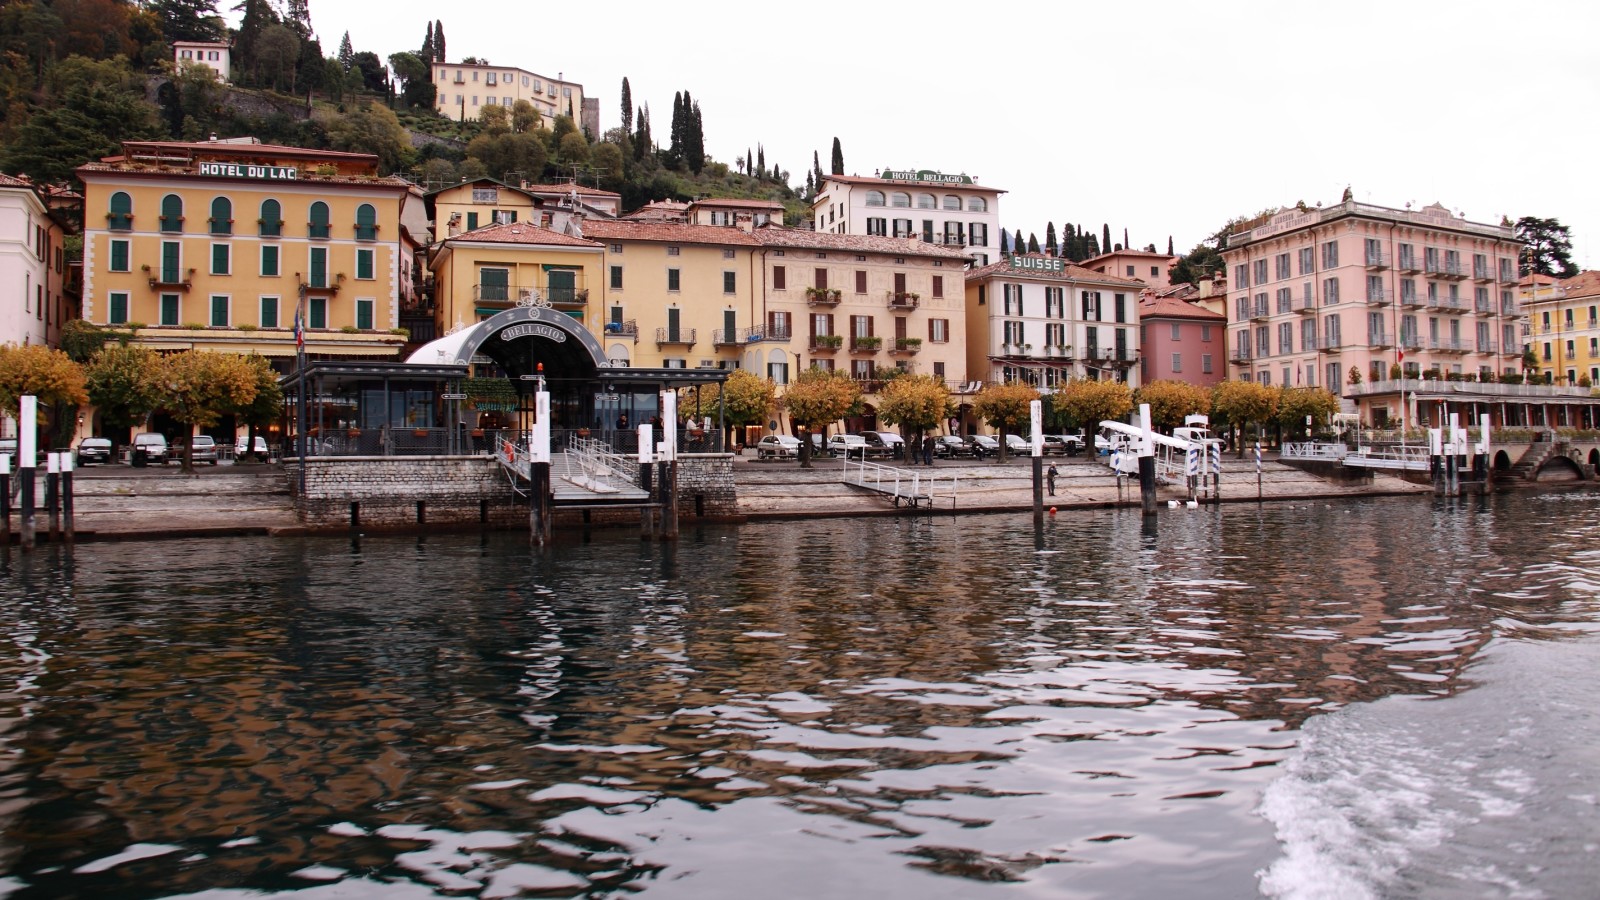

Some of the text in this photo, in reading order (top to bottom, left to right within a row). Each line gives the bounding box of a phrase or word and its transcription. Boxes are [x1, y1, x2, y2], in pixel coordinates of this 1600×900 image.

[201, 164, 295, 179] HOTEL DU LAC
[892, 172, 964, 183] HOTEL BELLAGIO
[1014, 256, 1060, 270] SUISSE
[507, 325, 560, 339] BELLAGIO
